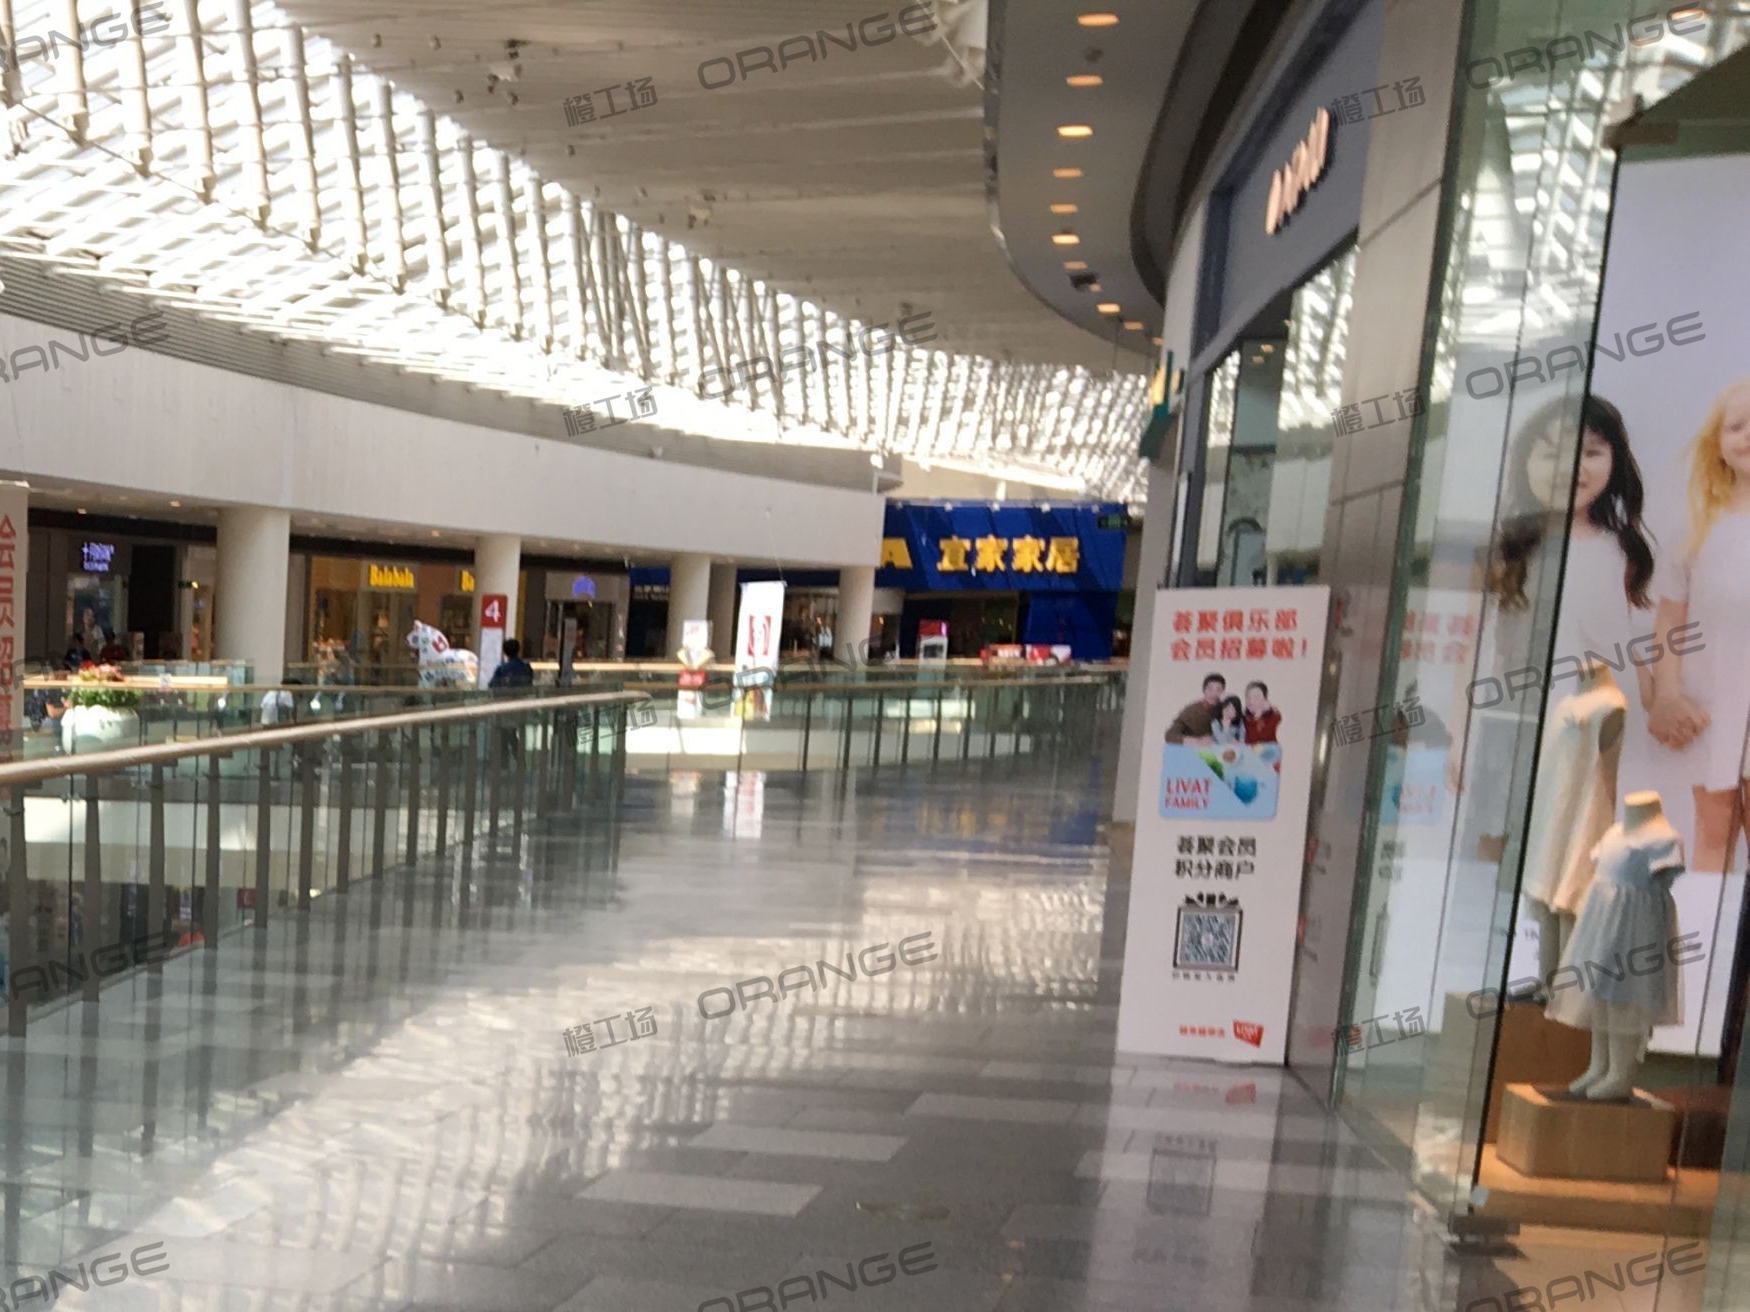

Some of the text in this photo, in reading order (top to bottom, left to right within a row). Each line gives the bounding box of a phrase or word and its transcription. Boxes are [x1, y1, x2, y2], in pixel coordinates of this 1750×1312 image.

[937, 534, 1080, 574] 宜家家居
[369, 564, 415, 590] Balabala
[484, 599, 502, 623] 4
[1172, 608, 1298, 634] 荟聚俱乐部
[1165, 776, 1212, 796] LIVAT
[1164, 795, 1210, 809] FAMILY
[1174, 858, 1256, 881] 积分商户
